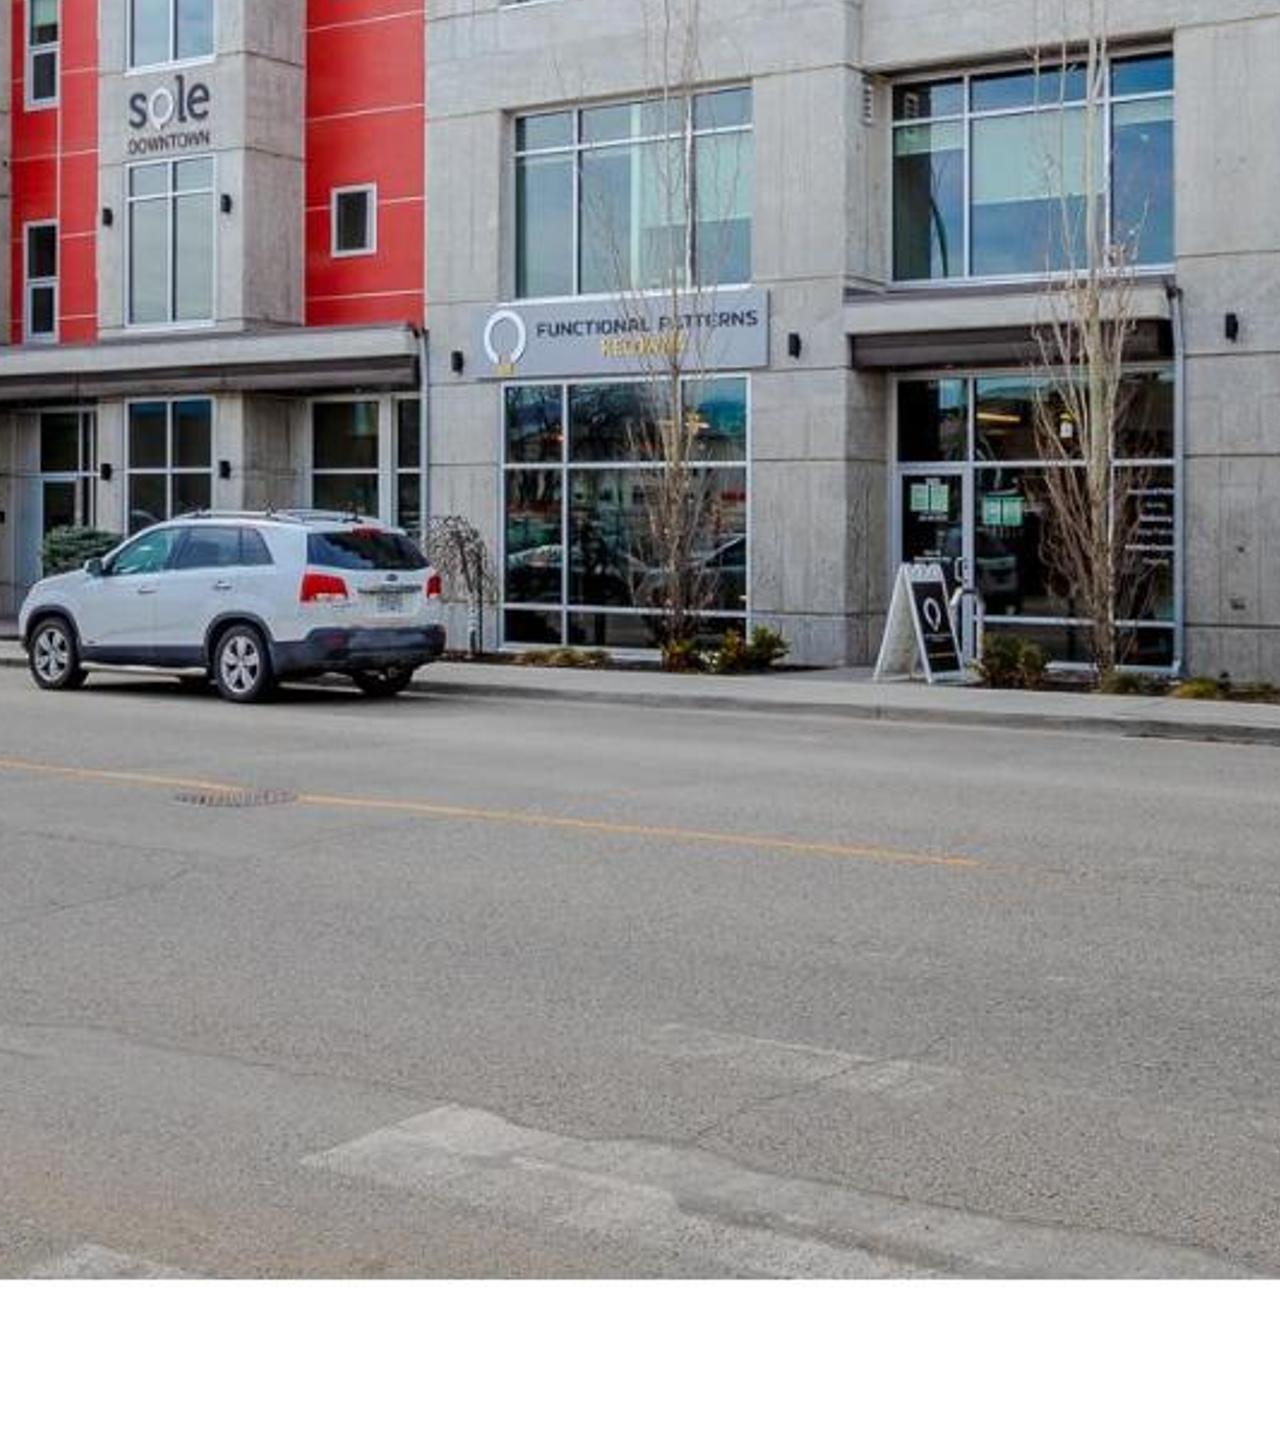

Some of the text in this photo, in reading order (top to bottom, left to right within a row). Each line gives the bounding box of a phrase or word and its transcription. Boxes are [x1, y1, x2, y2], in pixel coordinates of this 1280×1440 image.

[129, 74, 211, 130] sole
[128, 131, 211, 155] DOWNTOWN
[536, 316, 651, 338] FUNCTIONAL
